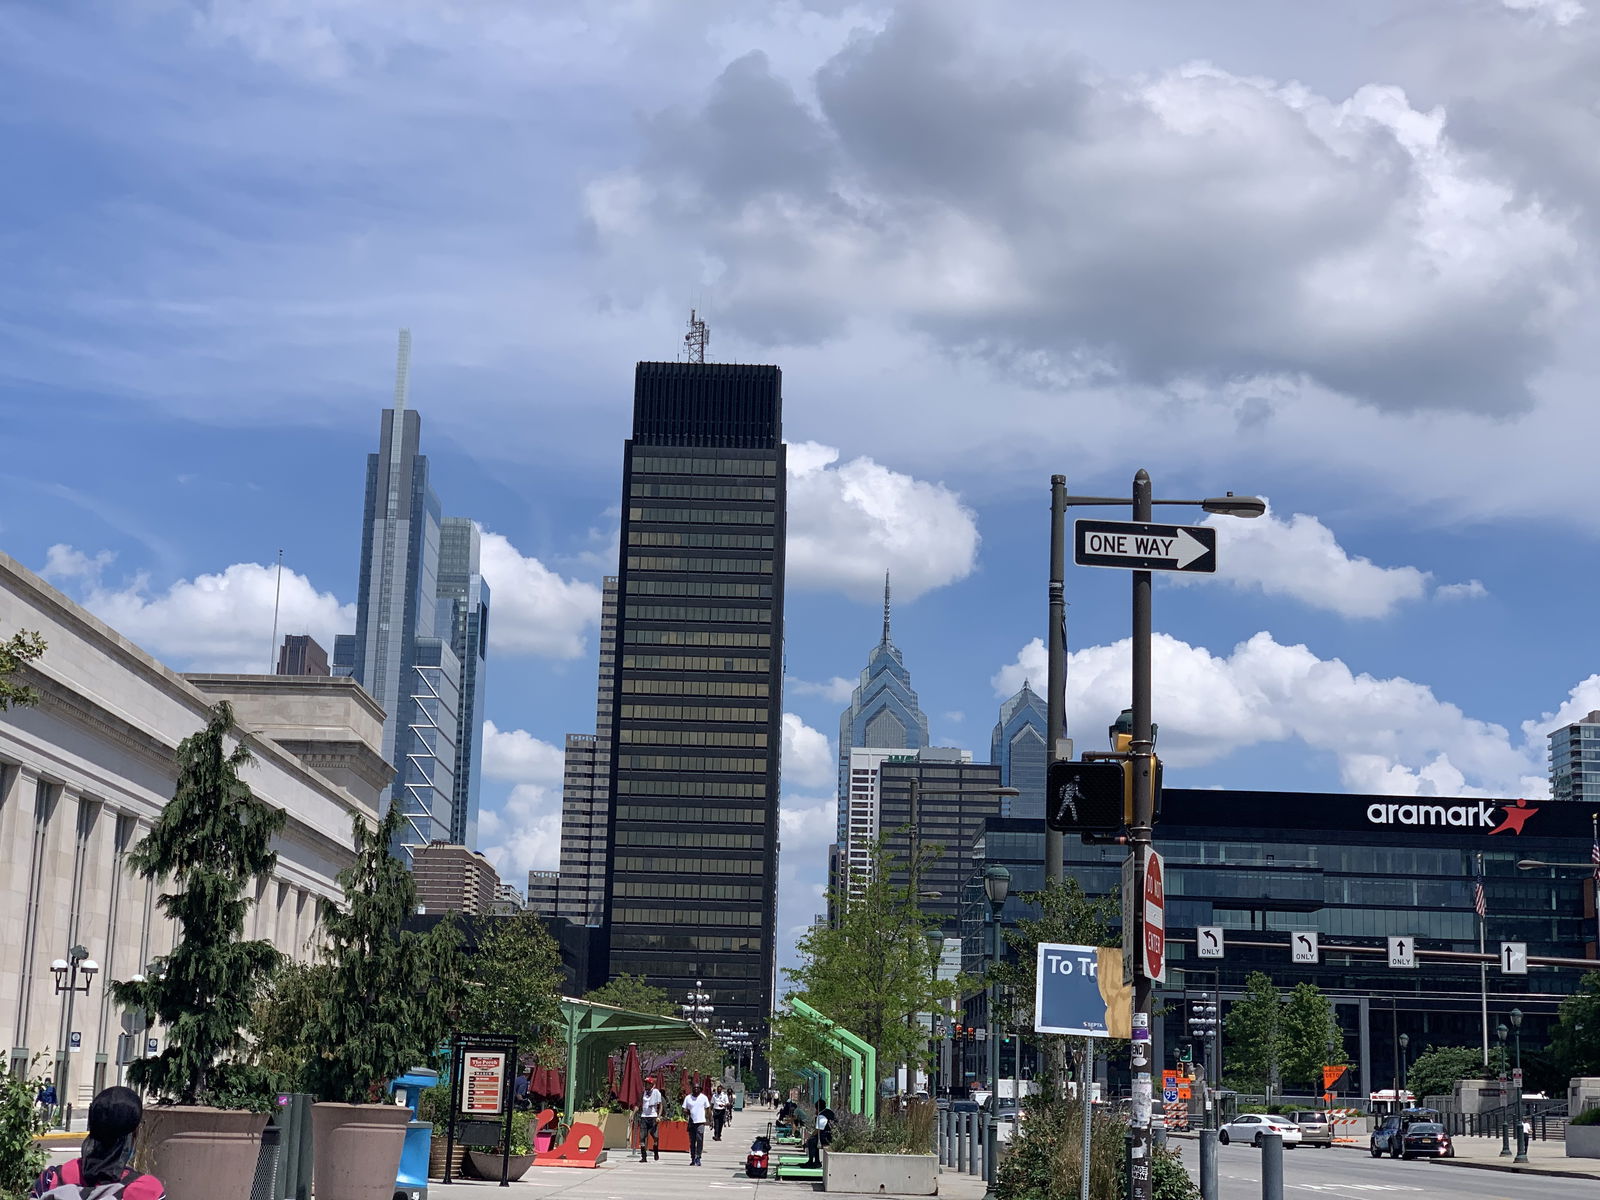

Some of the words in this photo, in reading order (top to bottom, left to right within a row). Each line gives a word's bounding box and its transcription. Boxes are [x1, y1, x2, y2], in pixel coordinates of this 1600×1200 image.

[1090, 534, 1128, 554] ONE
[1134, 537, 1174, 556] WAY
[1366, 801, 1496, 827] aramark
[1147, 931, 1161, 954] ENTER
[1047, 955, 1073, 975] To
[1165, 1090, 1178, 1100] 95
